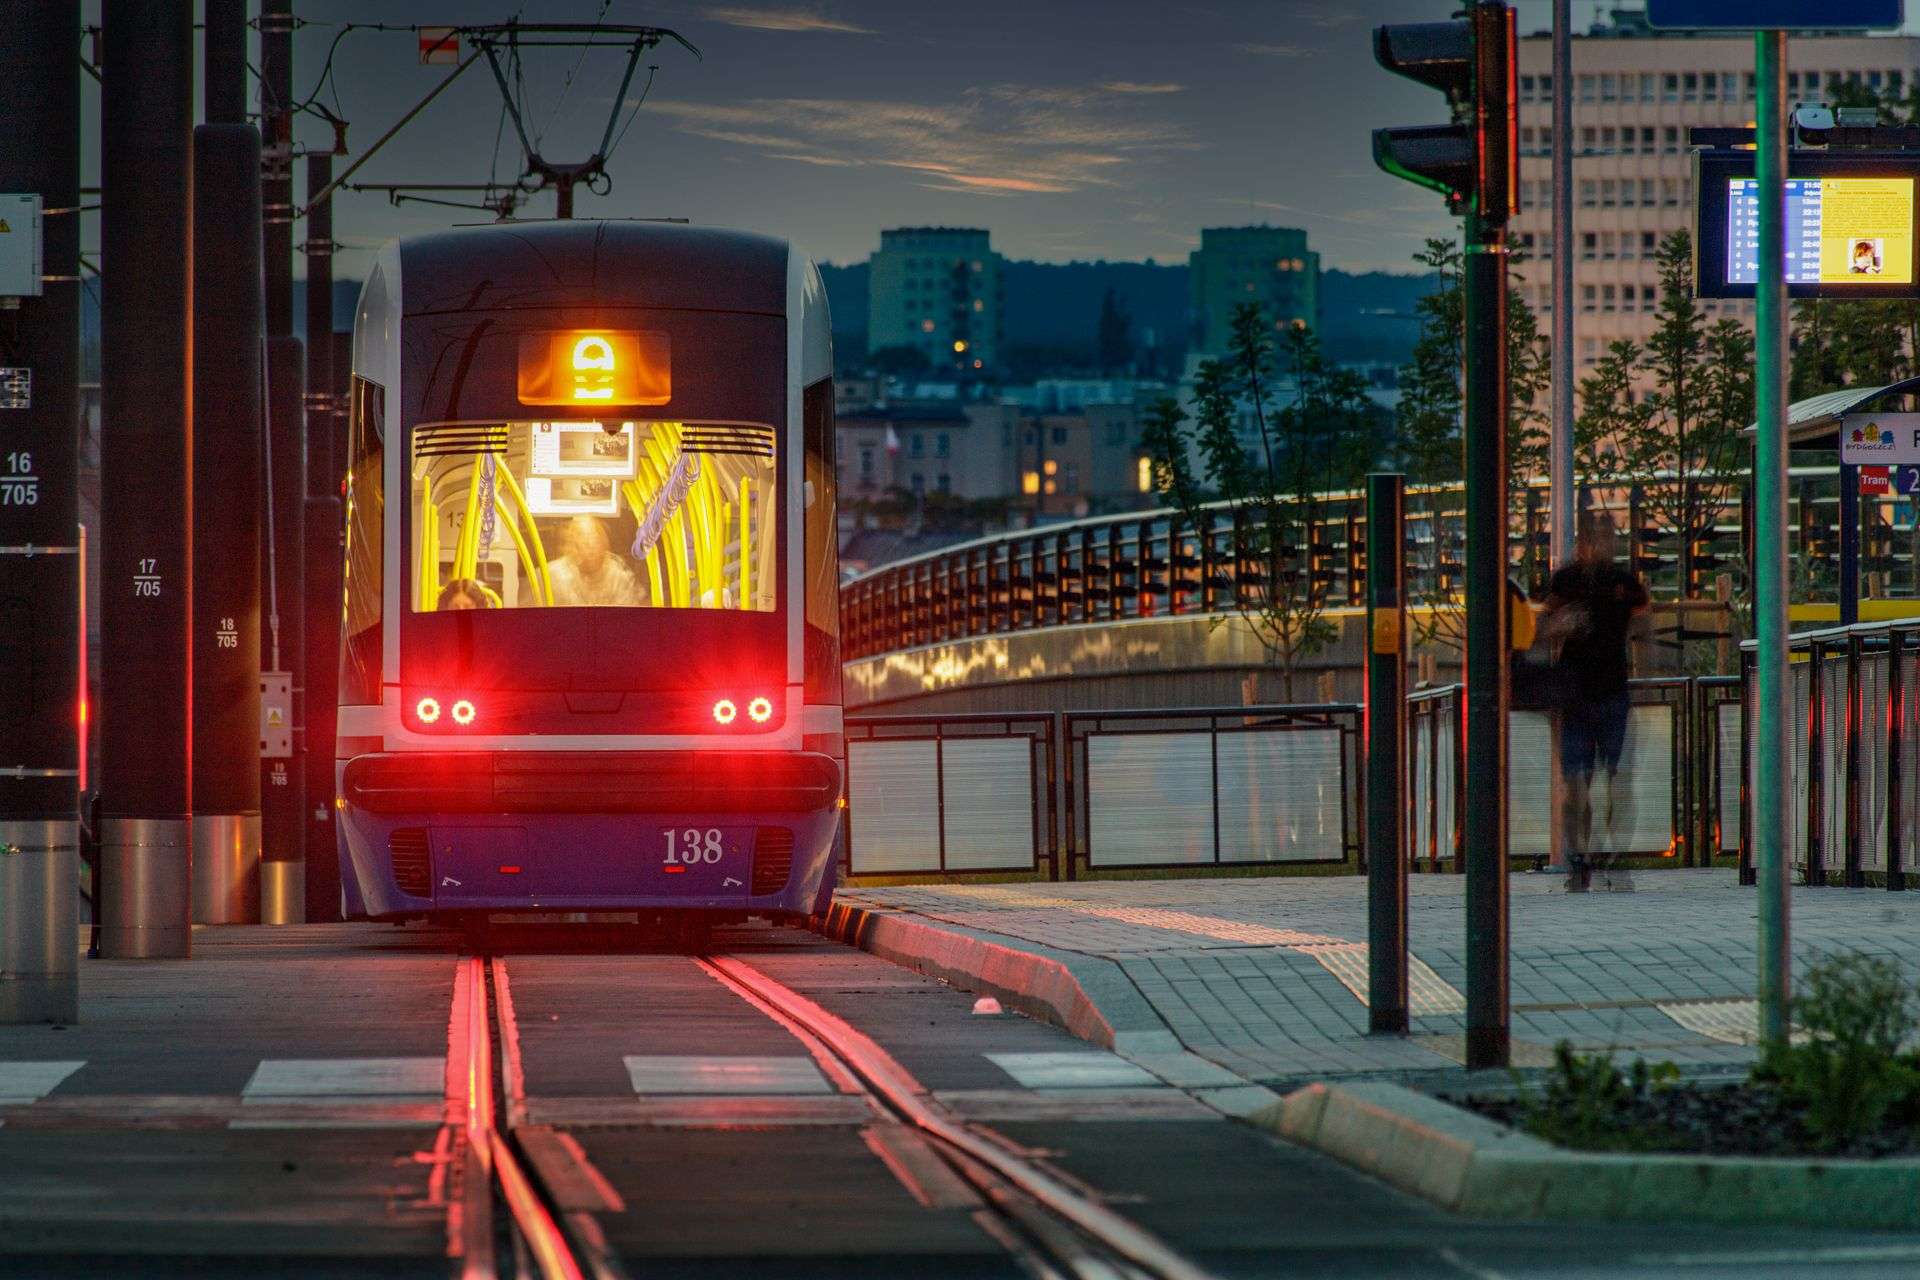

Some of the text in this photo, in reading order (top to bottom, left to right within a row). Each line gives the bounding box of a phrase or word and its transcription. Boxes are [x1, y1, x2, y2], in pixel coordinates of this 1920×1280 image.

[7, 452, 32, 473] 16
[1861, 474, 1888, 485] Tram
[0, 484, 38, 505] 705
[138, 559, 156, 573] 17
[134, 582, 161, 596] 705
[220, 618, 235, 631] 18
[217, 635, 238, 648] 705
[271, 776, 289, 786] 705
[663, 828, 723, 864] 138
